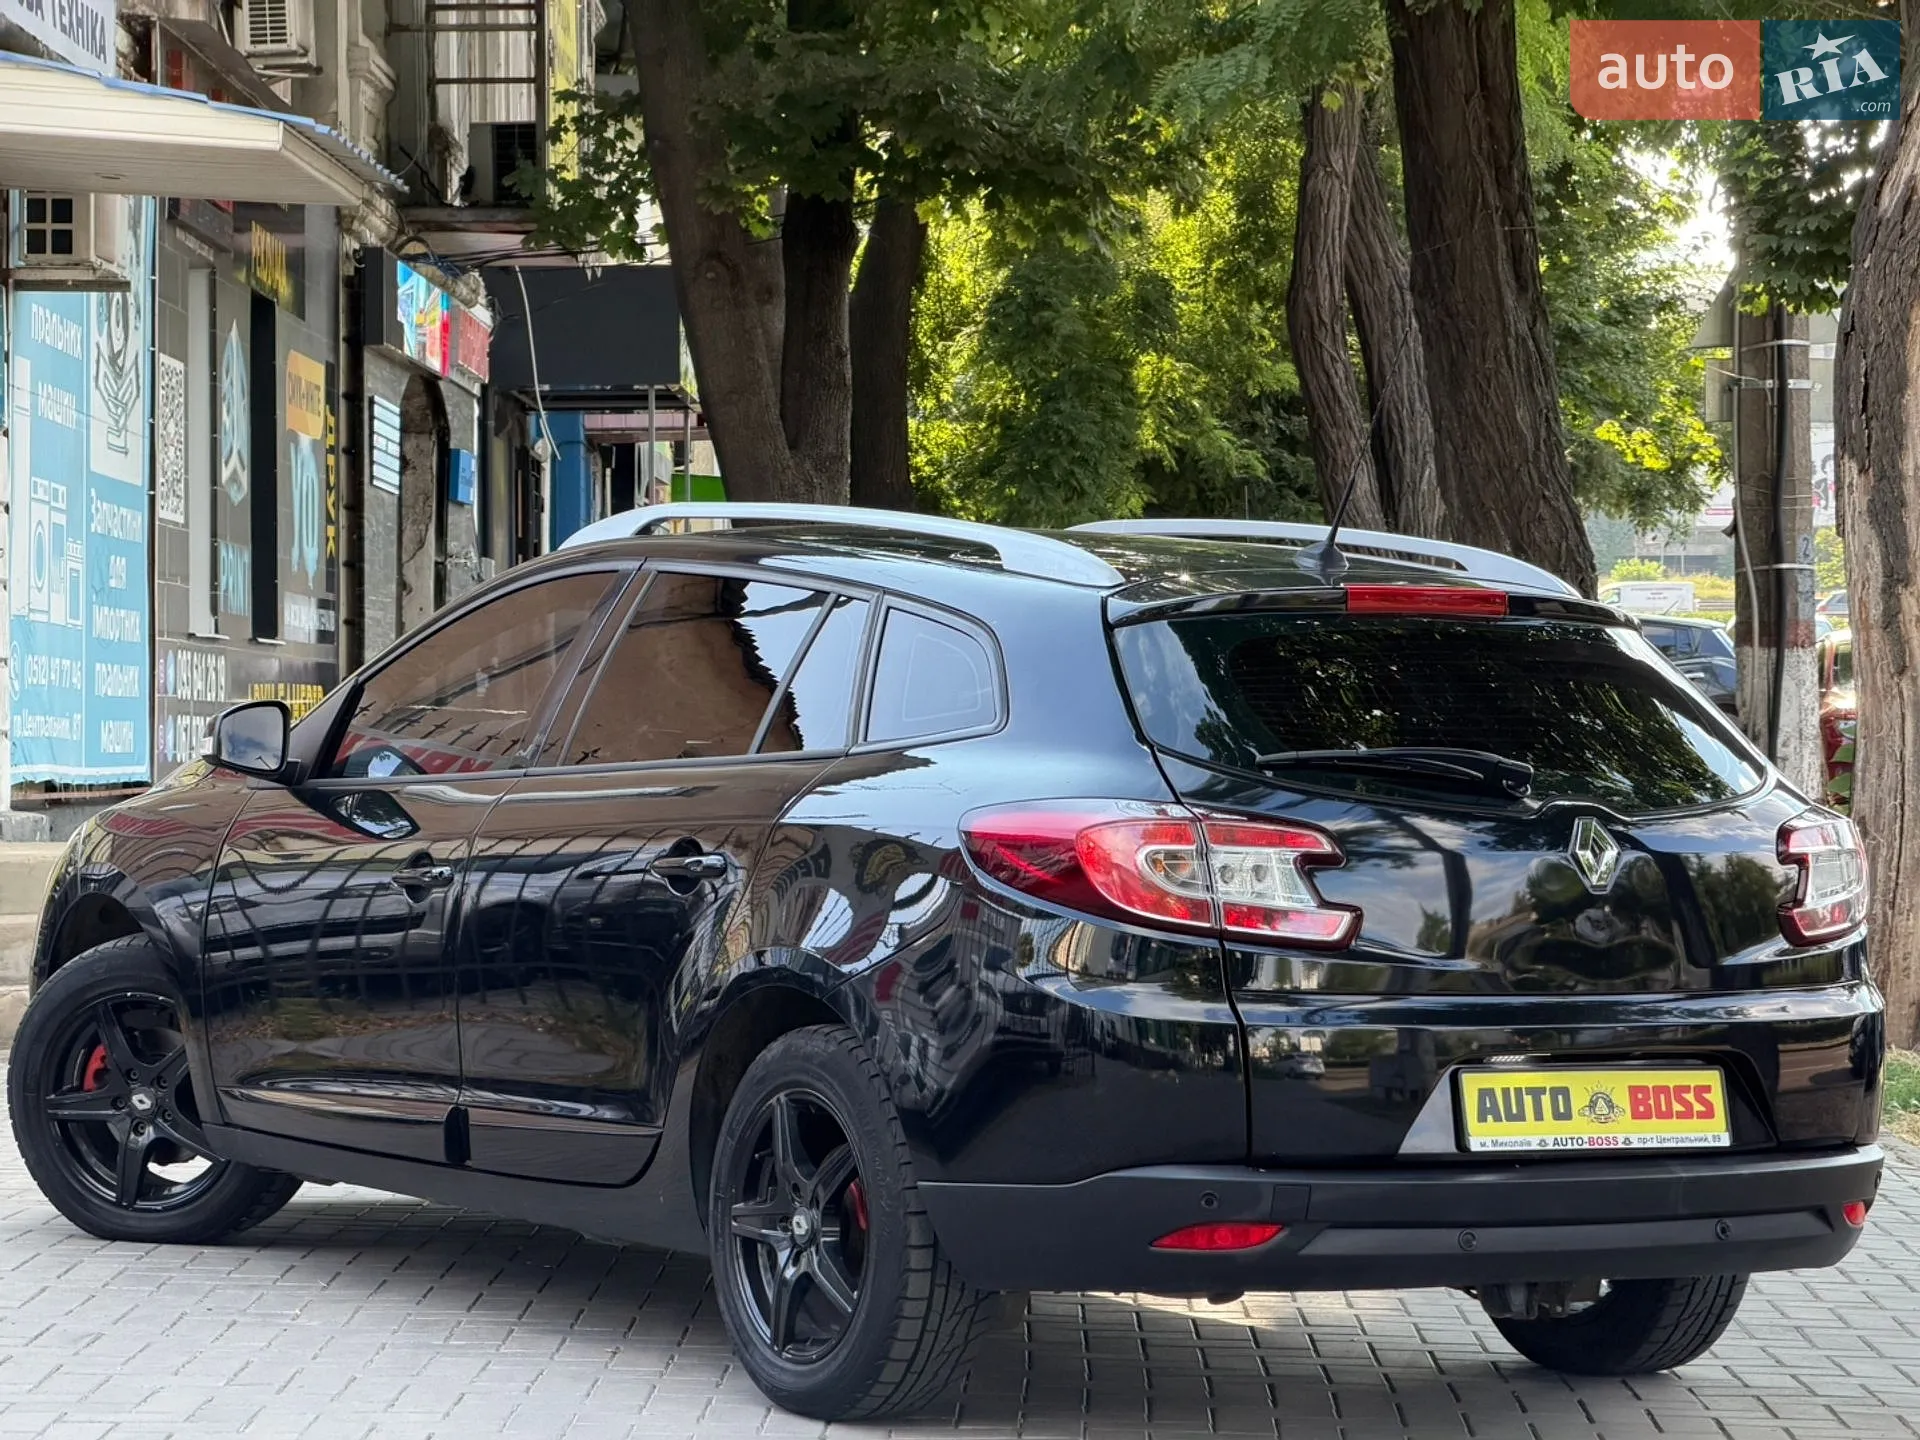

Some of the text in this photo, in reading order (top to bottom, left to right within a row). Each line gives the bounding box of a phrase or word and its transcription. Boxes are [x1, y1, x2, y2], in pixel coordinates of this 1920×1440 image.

[31, 303, 83, 361] пральних
[219, 541, 250, 616] PRINT
[1477, 1085, 1716, 1123] AUTO BOSS
[1552, 1136, 1619, 1148] AUTO-BOSS
